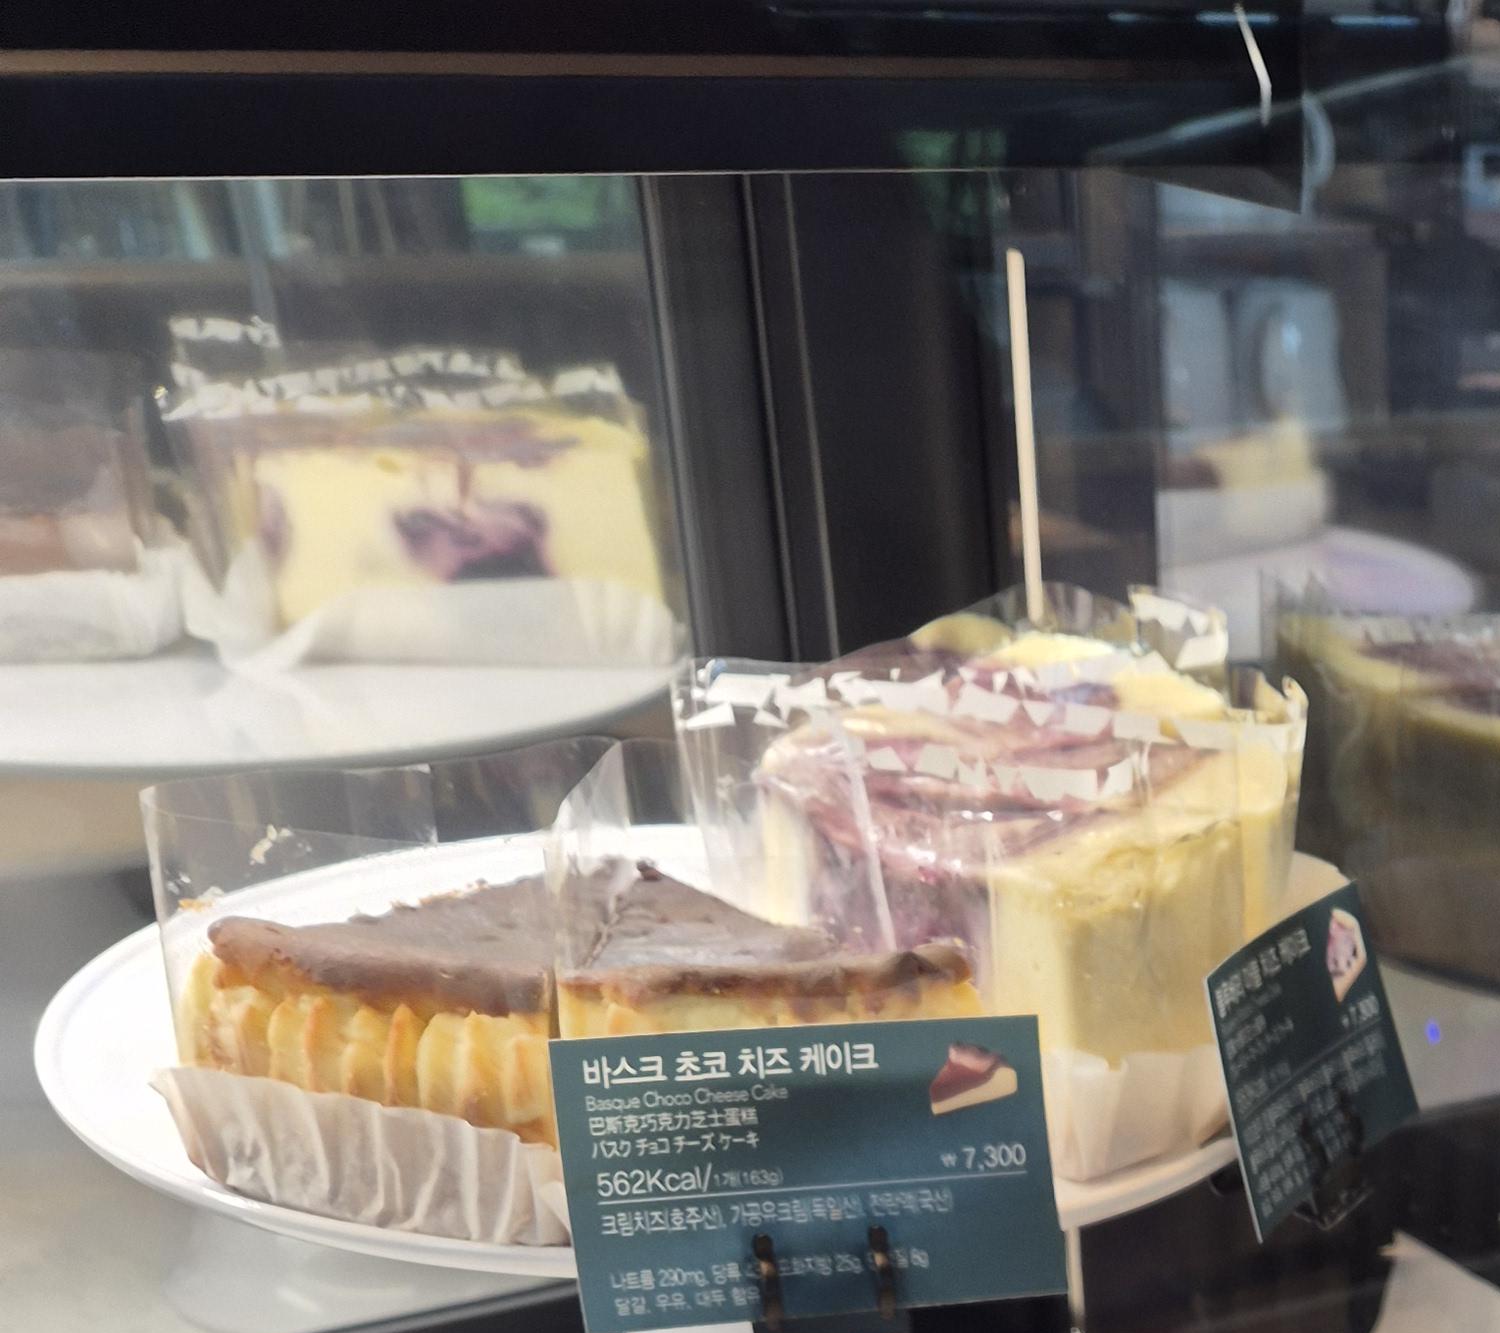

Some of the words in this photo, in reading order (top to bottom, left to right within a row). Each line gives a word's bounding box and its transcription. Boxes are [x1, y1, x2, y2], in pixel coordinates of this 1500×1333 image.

[583, 1055, 668, 1089] 바스크
[674, 1049, 731, 1082] 초코
[738, 1045, 793, 1079] 치즈
[799, 1041, 880, 1077] 케이크
[584, 1094, 641, 1113] Basque
[642, 1090, 693, 1109] Choco
[694, 1086, 750, 1106] Cheese
[751, 1083, 790, 1101] Cake
[963, 1142, 1028, 1171] 7,300
[610, 1268, 655, 1291] 나트륨
